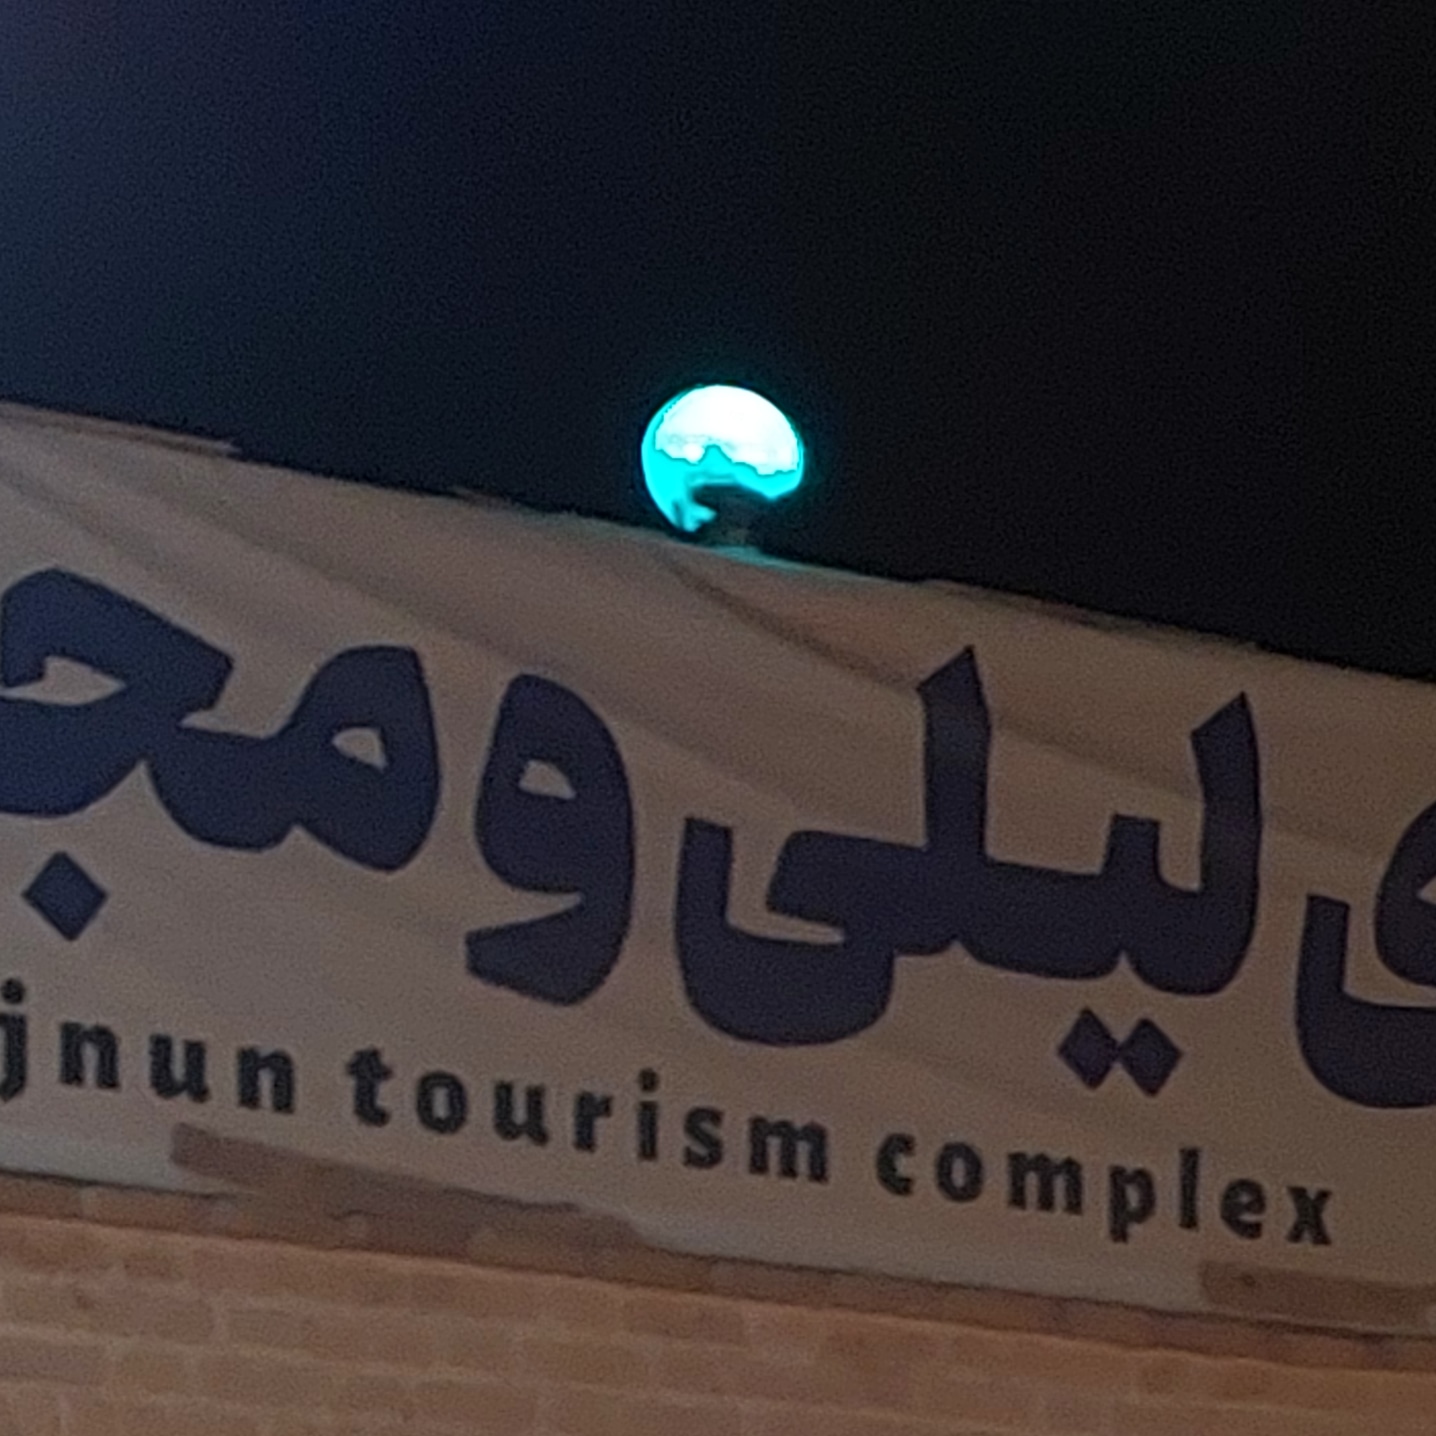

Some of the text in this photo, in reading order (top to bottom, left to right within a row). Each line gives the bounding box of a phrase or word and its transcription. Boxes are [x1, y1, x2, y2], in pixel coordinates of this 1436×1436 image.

[674, 644, 1264, 1098] لیلی
[346, 1046, 830, 1184] tourism
[875, 1132, 1334, 1246] complex
